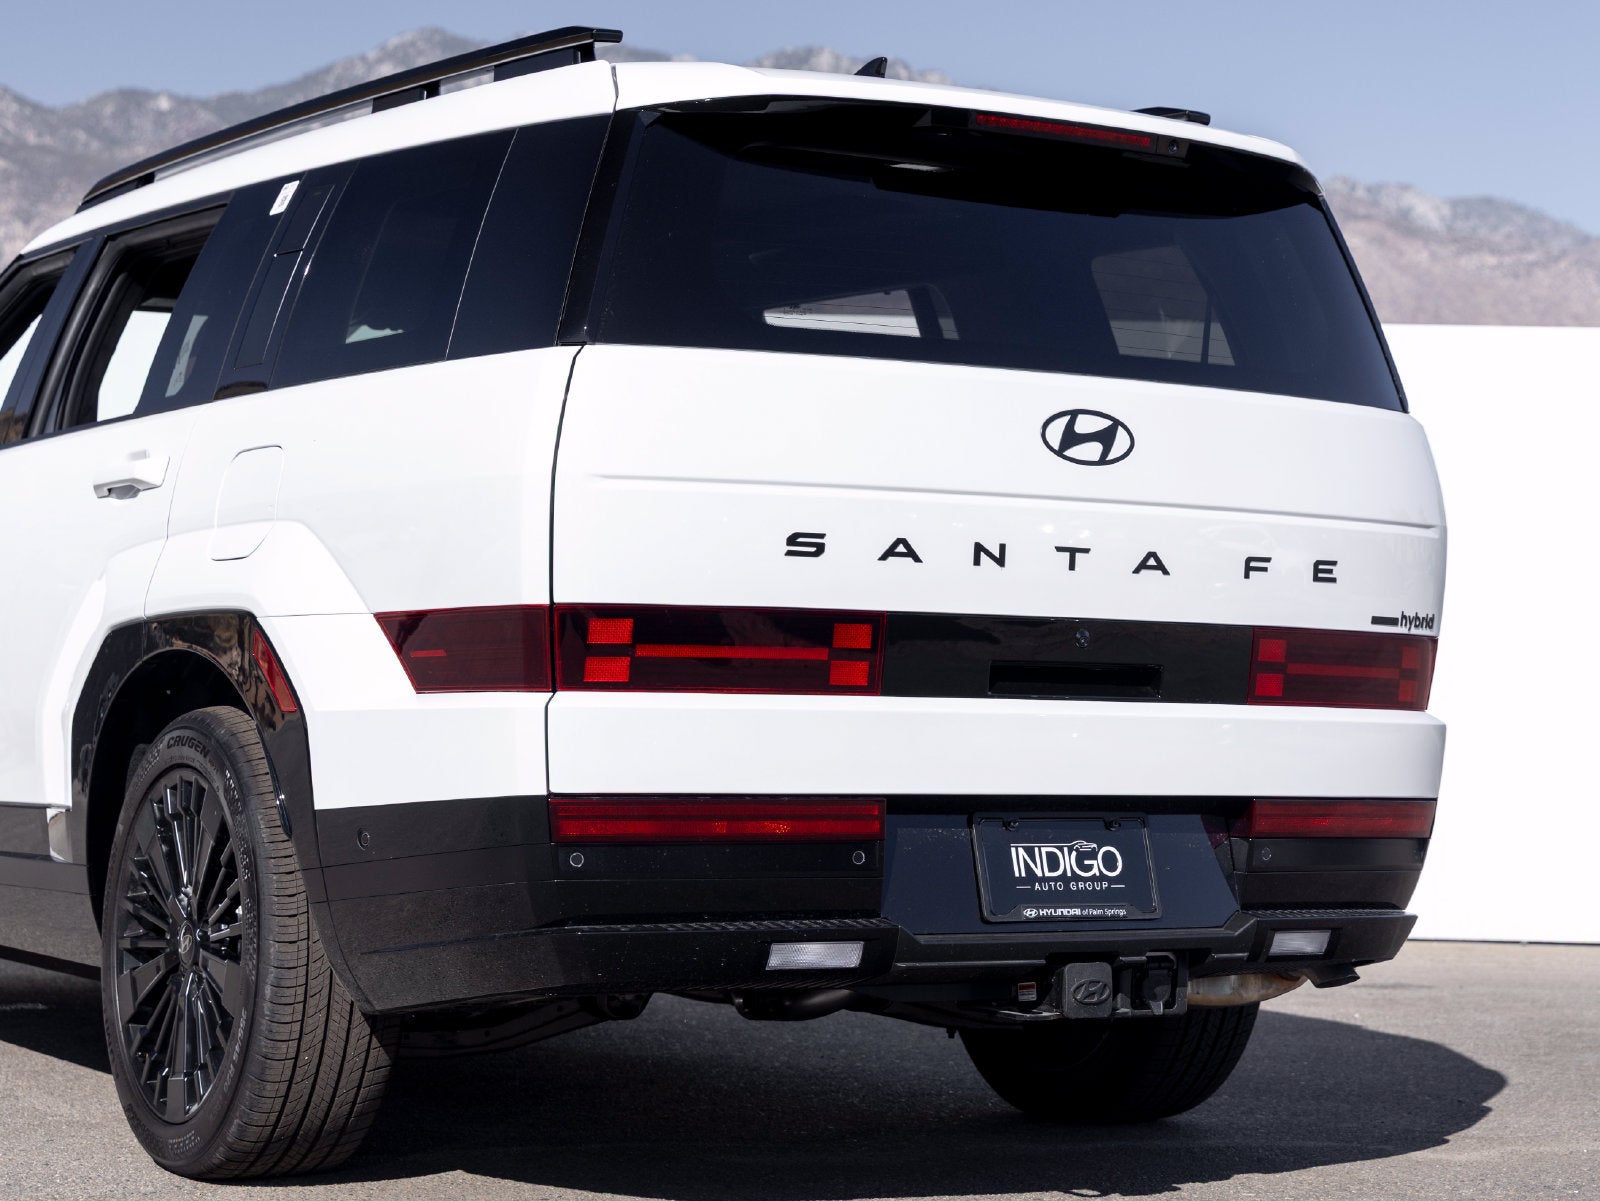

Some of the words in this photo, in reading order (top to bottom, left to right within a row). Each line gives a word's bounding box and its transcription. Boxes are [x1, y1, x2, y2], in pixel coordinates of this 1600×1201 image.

[785, 531, 1171, 576] SANTA
[1243, 556, 1338, 584] FE
[1400, 610, 1435, 632] hybrid
[166, 735, 211, 759] CRUGEN
[1010, 845, 1123, 877] INDIGO
[1034, 881, 1064, 891] AUTO
[1069, 881, 1109, 891] GROUP
[1039, 908, 1081, 916] HYUNDAI
[1082, 908, 1088, 916] of
[1089, 908, 1103, 916] Palm
[1104, 907, 1127, 918] Springs
